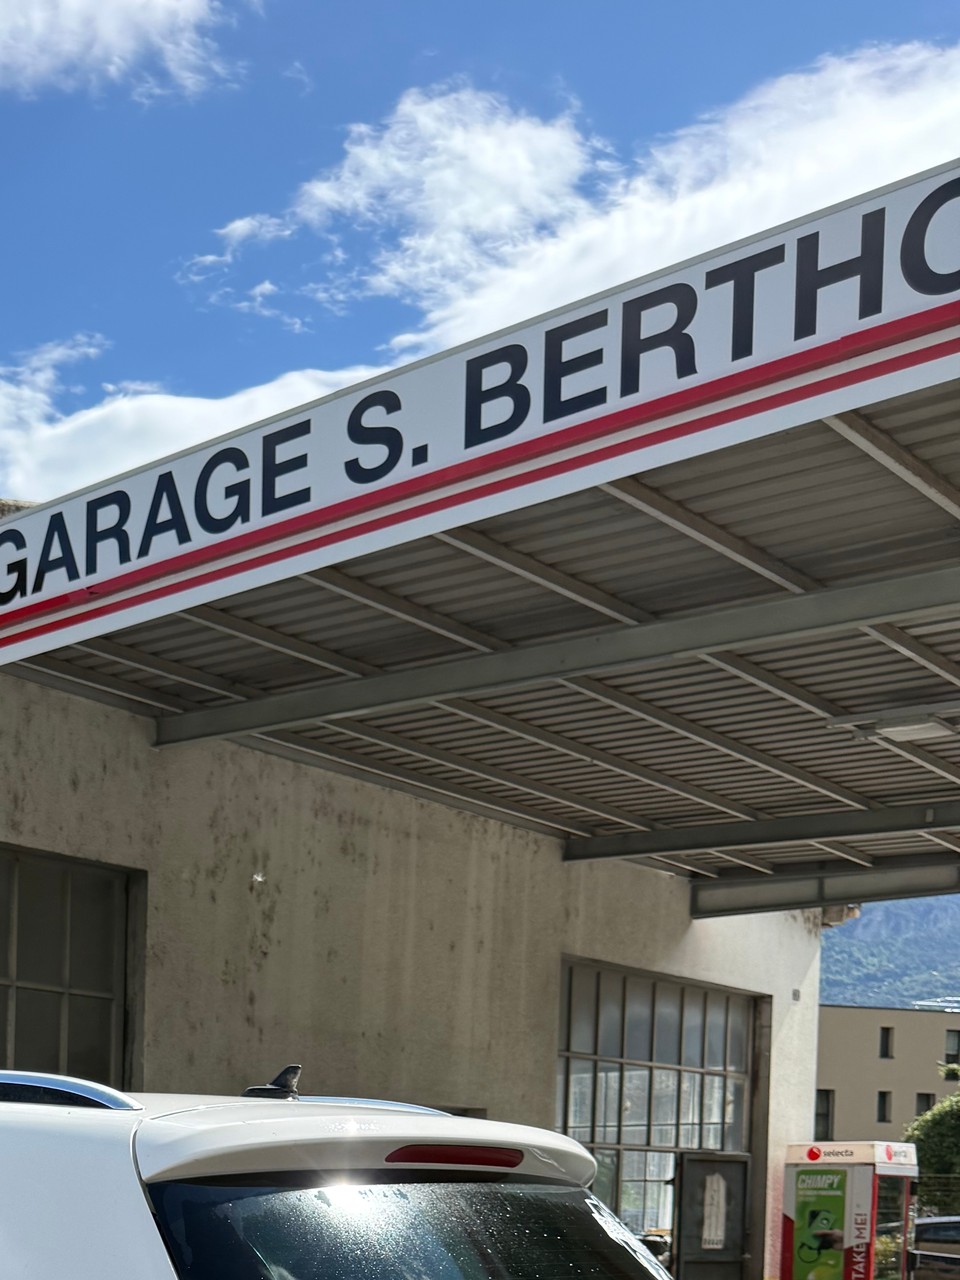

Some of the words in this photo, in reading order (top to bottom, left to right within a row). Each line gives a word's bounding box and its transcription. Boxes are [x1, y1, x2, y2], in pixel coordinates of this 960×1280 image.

[344, 390, 429, 484] S.
[823, 1149, 854, 1158] selecta
[797, 1174, 841, 1189] CHIMPY
[854, 1213, 867, 1240] ME!
[851, 1243, 866, 1280] TAKE
